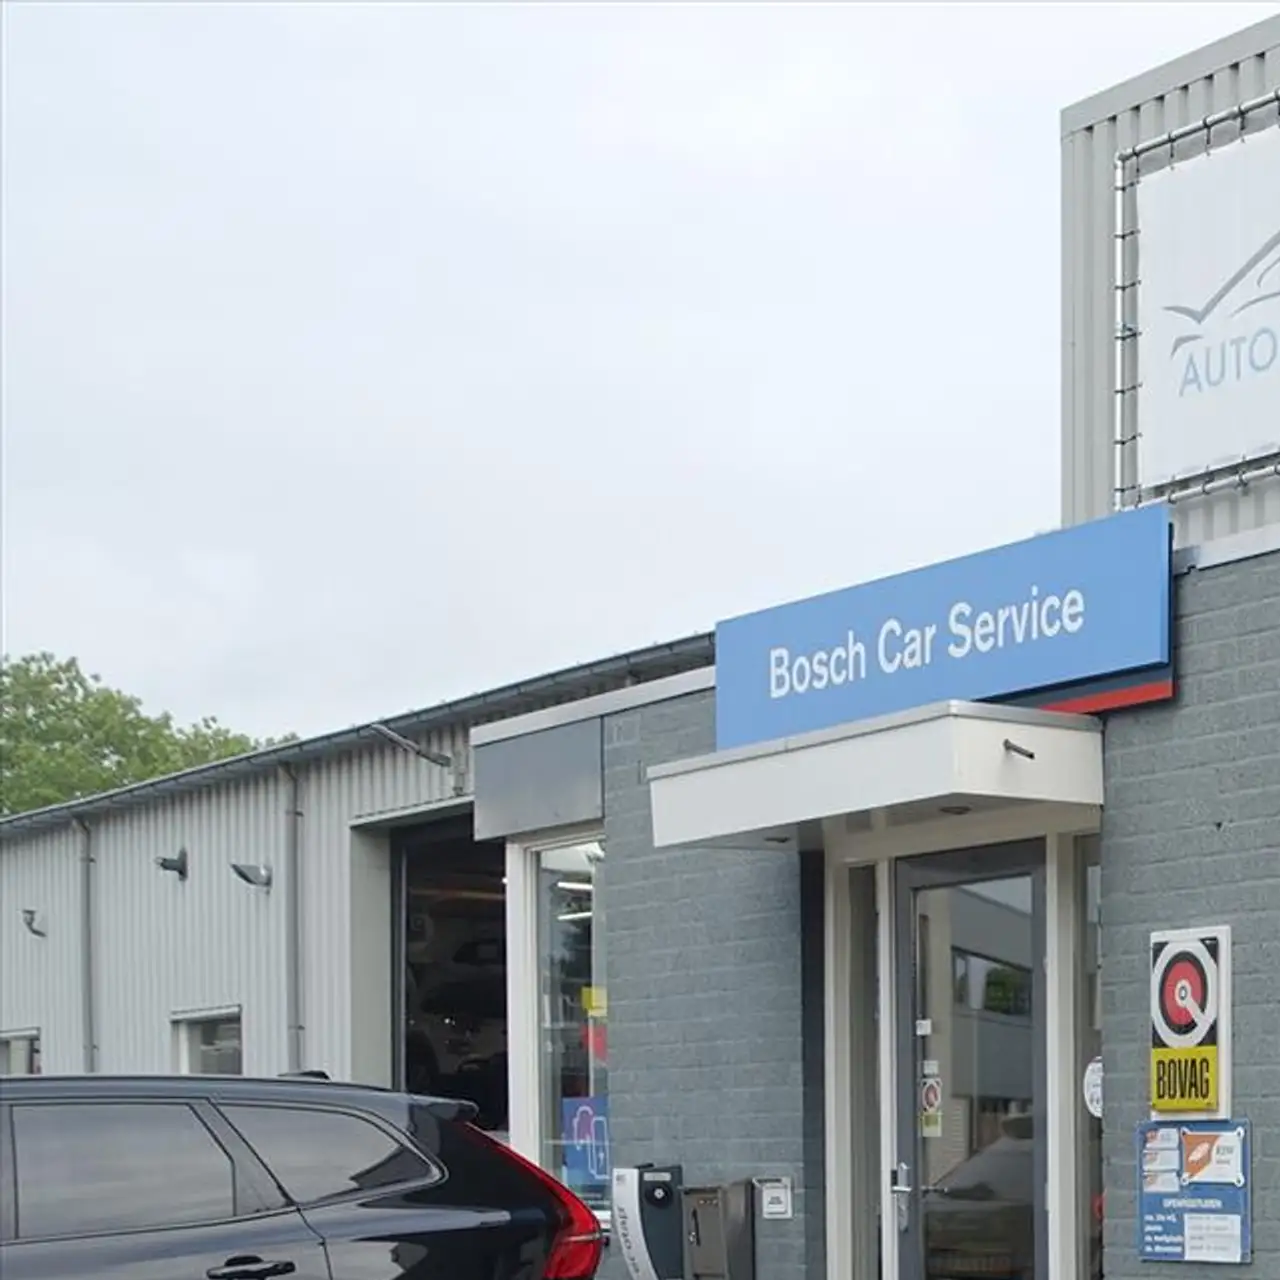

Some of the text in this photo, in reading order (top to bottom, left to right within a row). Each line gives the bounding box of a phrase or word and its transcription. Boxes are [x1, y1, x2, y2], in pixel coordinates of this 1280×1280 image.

[769, 585, 1085, 698] Bosch Car Service
[1155, 1057, 1211, 1100] BOVAG
